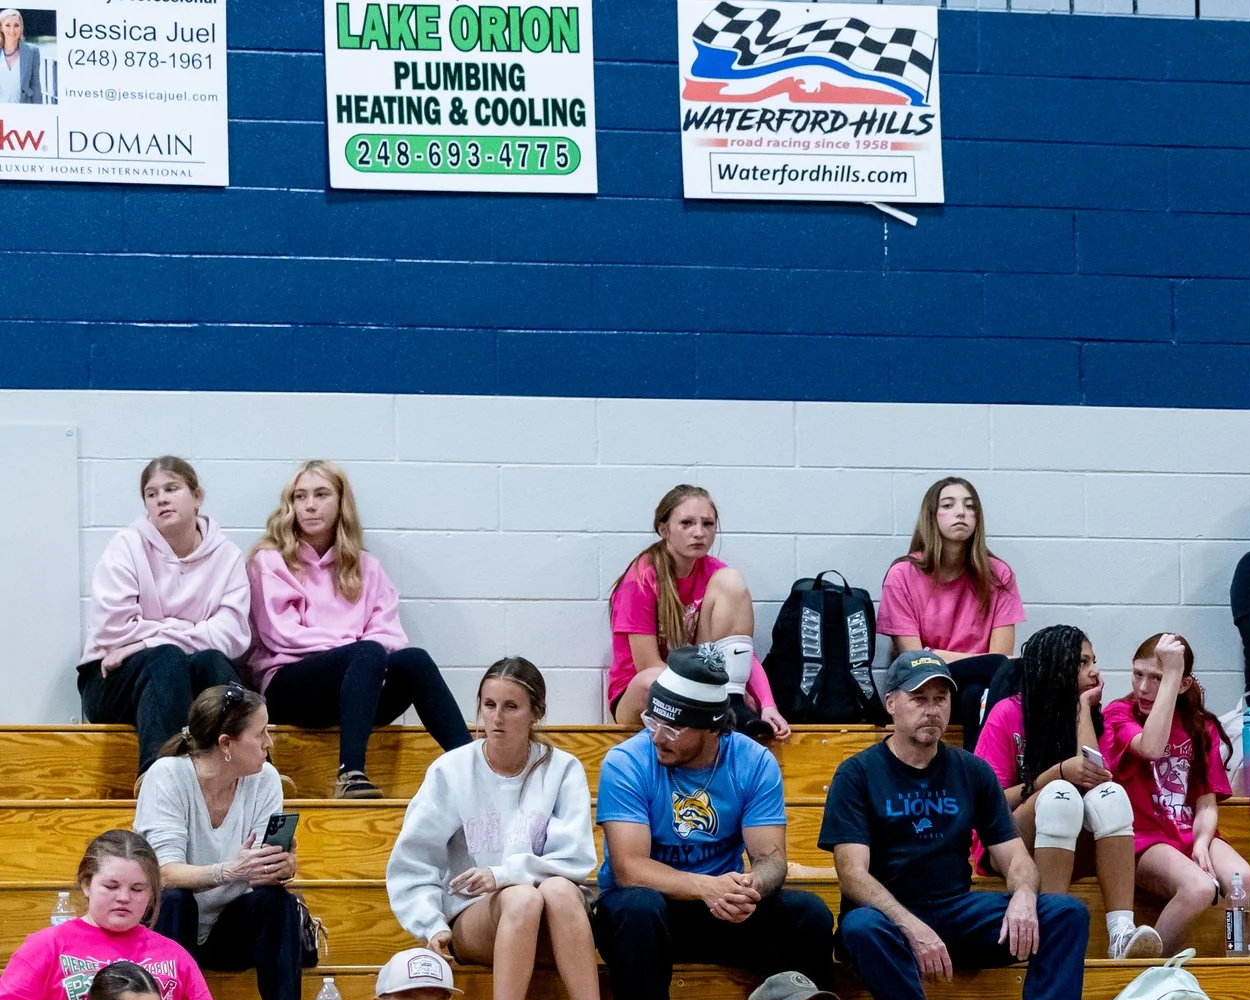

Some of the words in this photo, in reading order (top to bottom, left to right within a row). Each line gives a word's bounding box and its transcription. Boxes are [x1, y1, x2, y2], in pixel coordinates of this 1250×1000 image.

[65, 18, 157, 41] Jessica
[166, 21, 216, 43] Juel
[336, 3, 442, 51] LAKE
[449, 5, 580, 53] ORION
[67, 48, 118, 71] (248)
[124, 51, 213, 70] 878-1961
[394, 61, 526, 92] PLUMBING
[65, 87, 219, 103] invest@jessicajuel.com
[336, 94, 442, 125] HEATING
[448, 97, 468, 126] &
[475, 98, 587, 127] COOLING
[682, 104, 849, 134] WATERFORD
[850, 107, 936, 138] HILLS
[0, 119, 45, 151] kw
[68, 131, 193, 156] DOMAIN
[730, 137, 762, 148] road
[766, 138, 811, 152] racing
[815, 138, 850, 149] since
[855, 139, 889, 151] 1958
[356, 140, 570, 170] 248-693-4775
[0, 164, 45, 173] LUXURY
[51, 166, 93, 175] HOMES
[98, 167, 194, 178] INTERNATIONAL
[717, 163, 908, 185] Waterfordhills.com
[886, 798, 959, 817] LIONS
[60, 955, 99, 977] PIERCE
